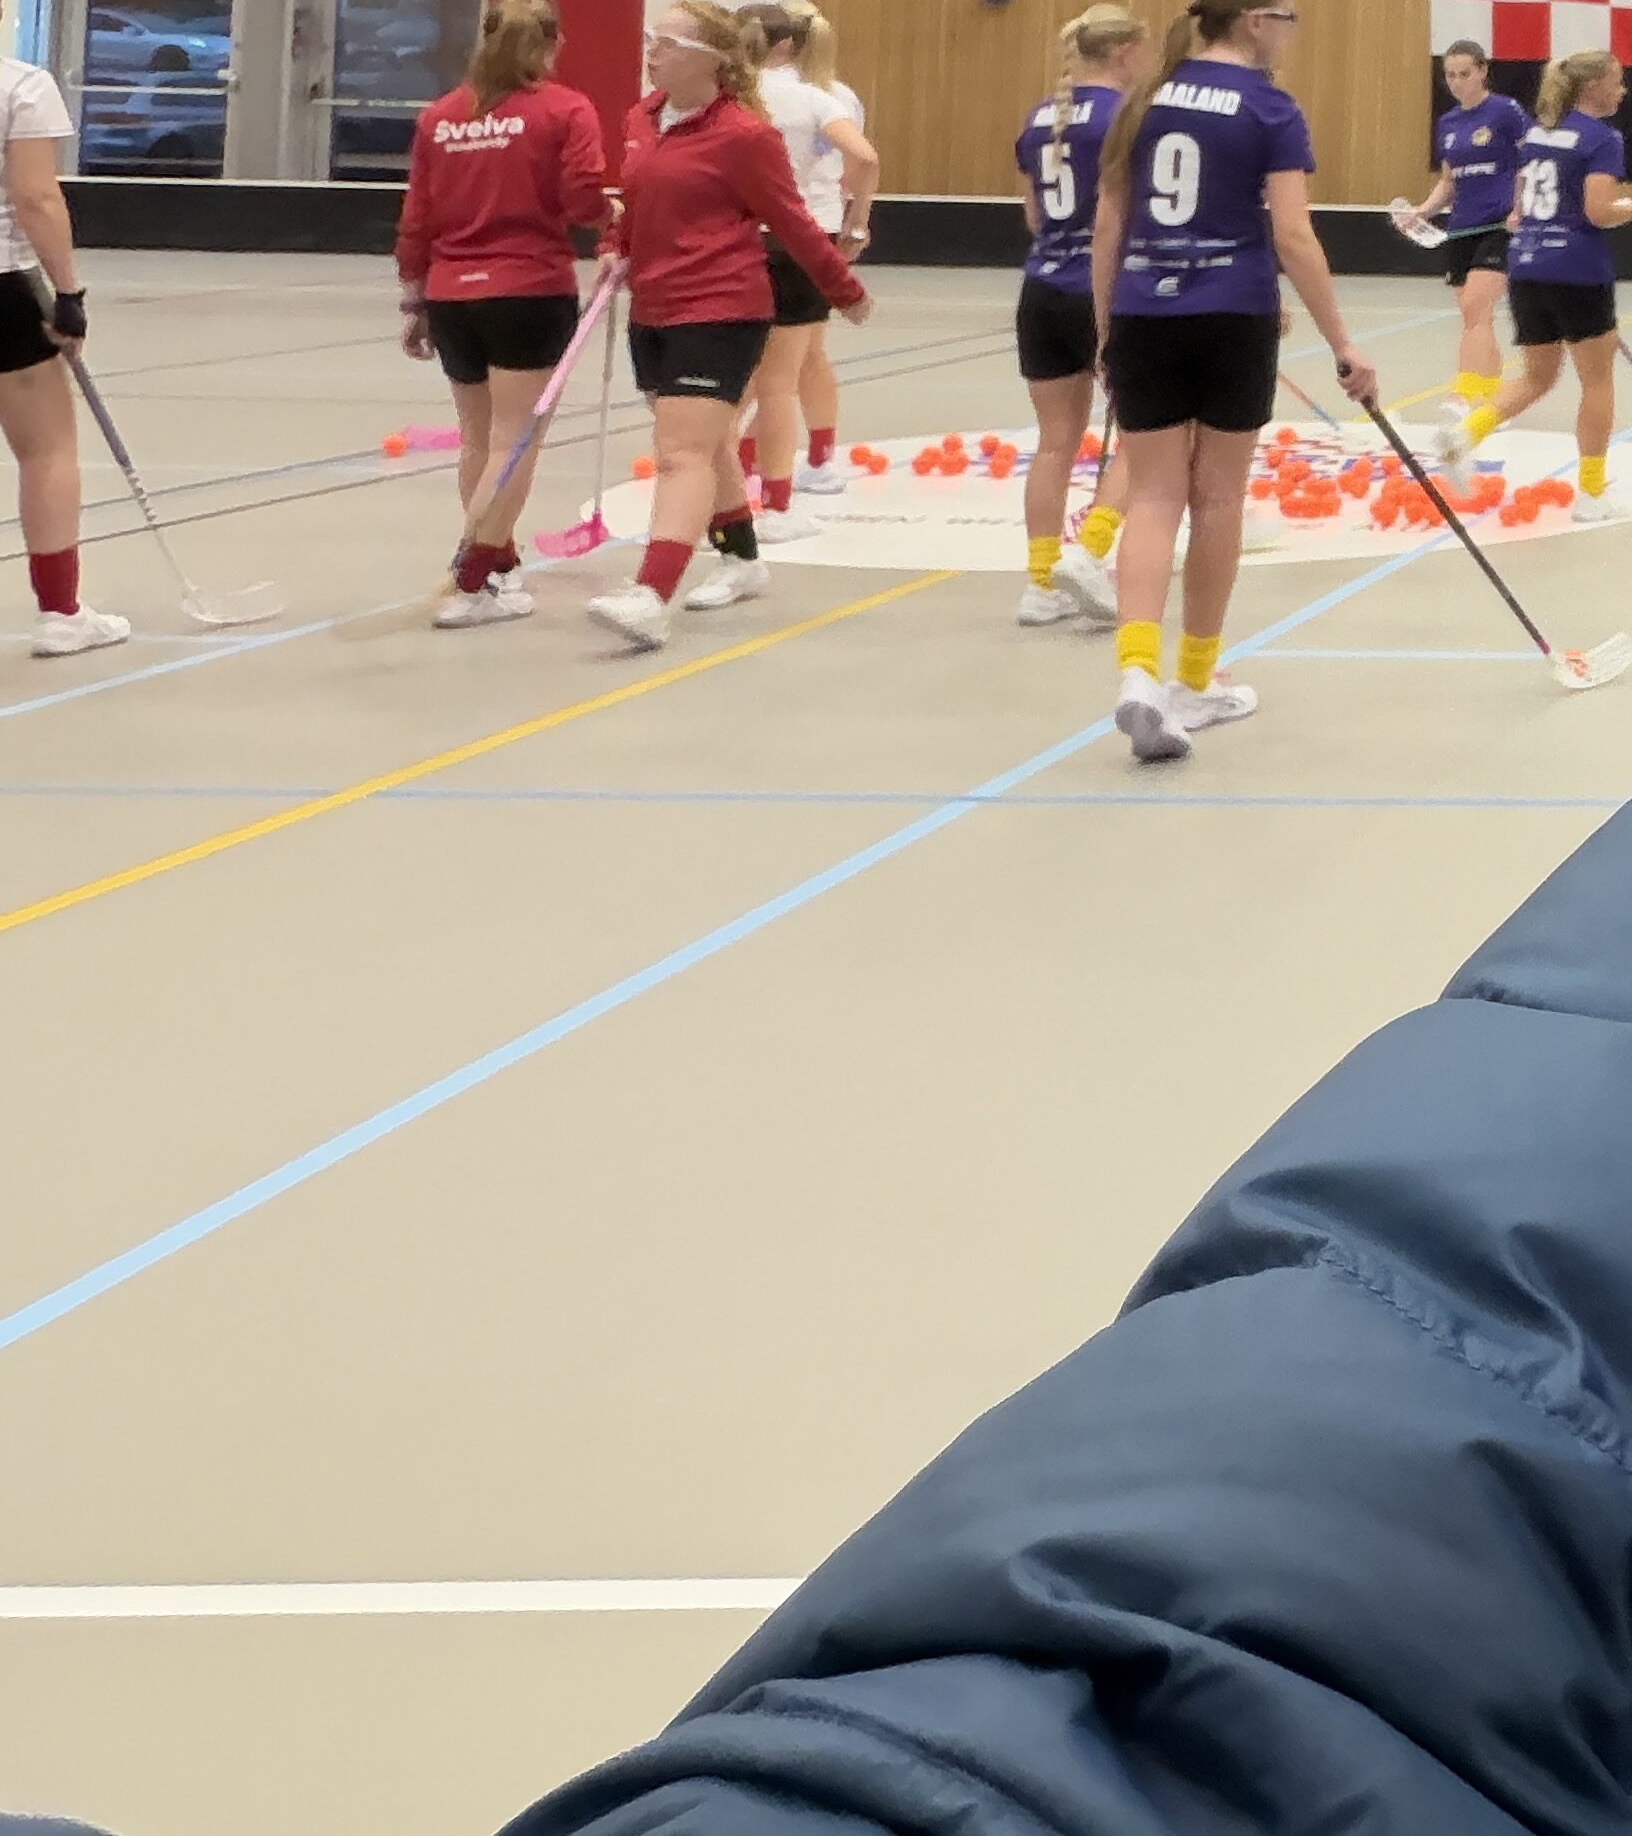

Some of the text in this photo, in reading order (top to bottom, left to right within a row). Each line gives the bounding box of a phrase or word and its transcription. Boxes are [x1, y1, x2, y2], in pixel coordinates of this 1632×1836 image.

[1041, 142, 1076, 221] 5
[1150, 131, 1200, 227] 9
[1519, 158, 1560, 221] 13
